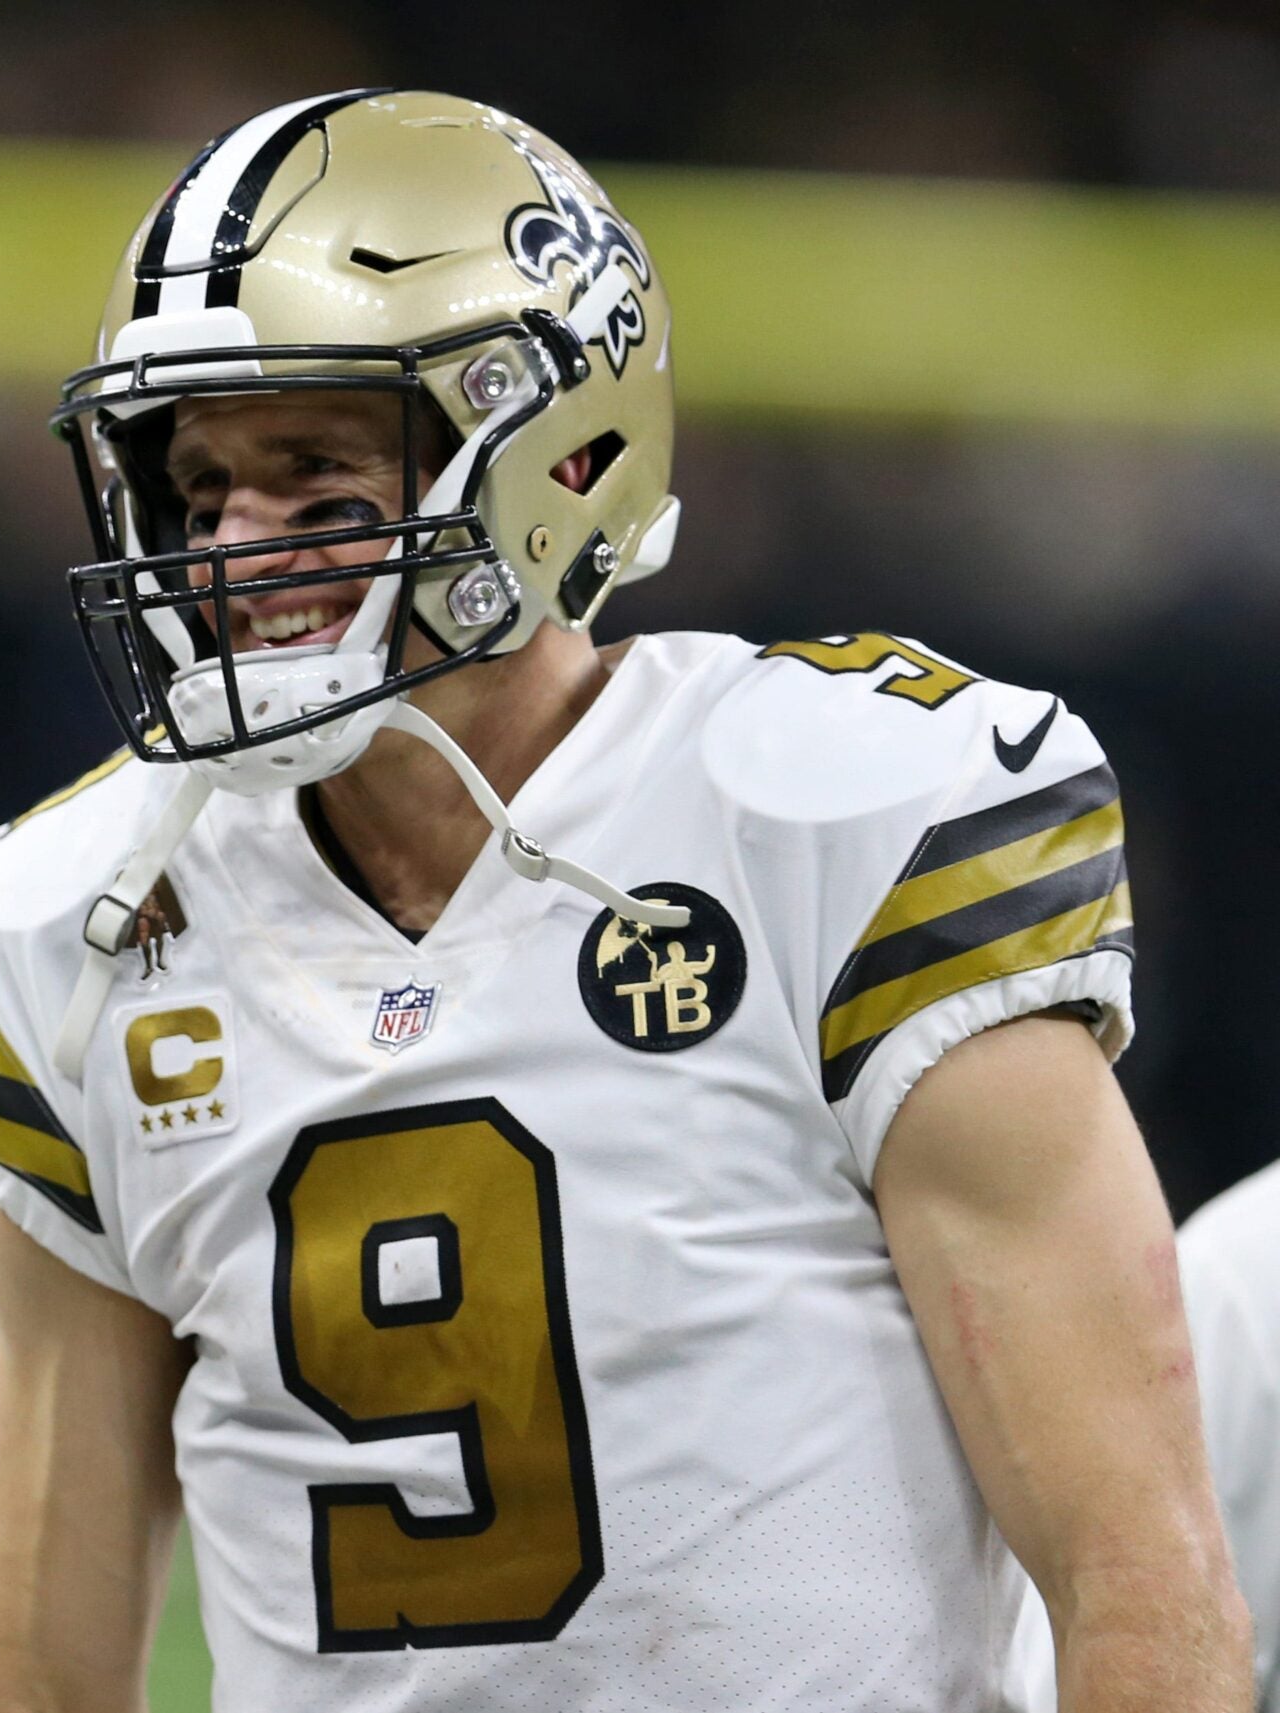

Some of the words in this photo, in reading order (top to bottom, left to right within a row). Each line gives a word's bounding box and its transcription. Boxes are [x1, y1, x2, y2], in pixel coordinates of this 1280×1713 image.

[378, 1010, 422, 1039] NFL
[615, 977, 711, 1037] TB
[125, 1005, 224, 1107] C
[267, 1096, 605, 1654] 9
